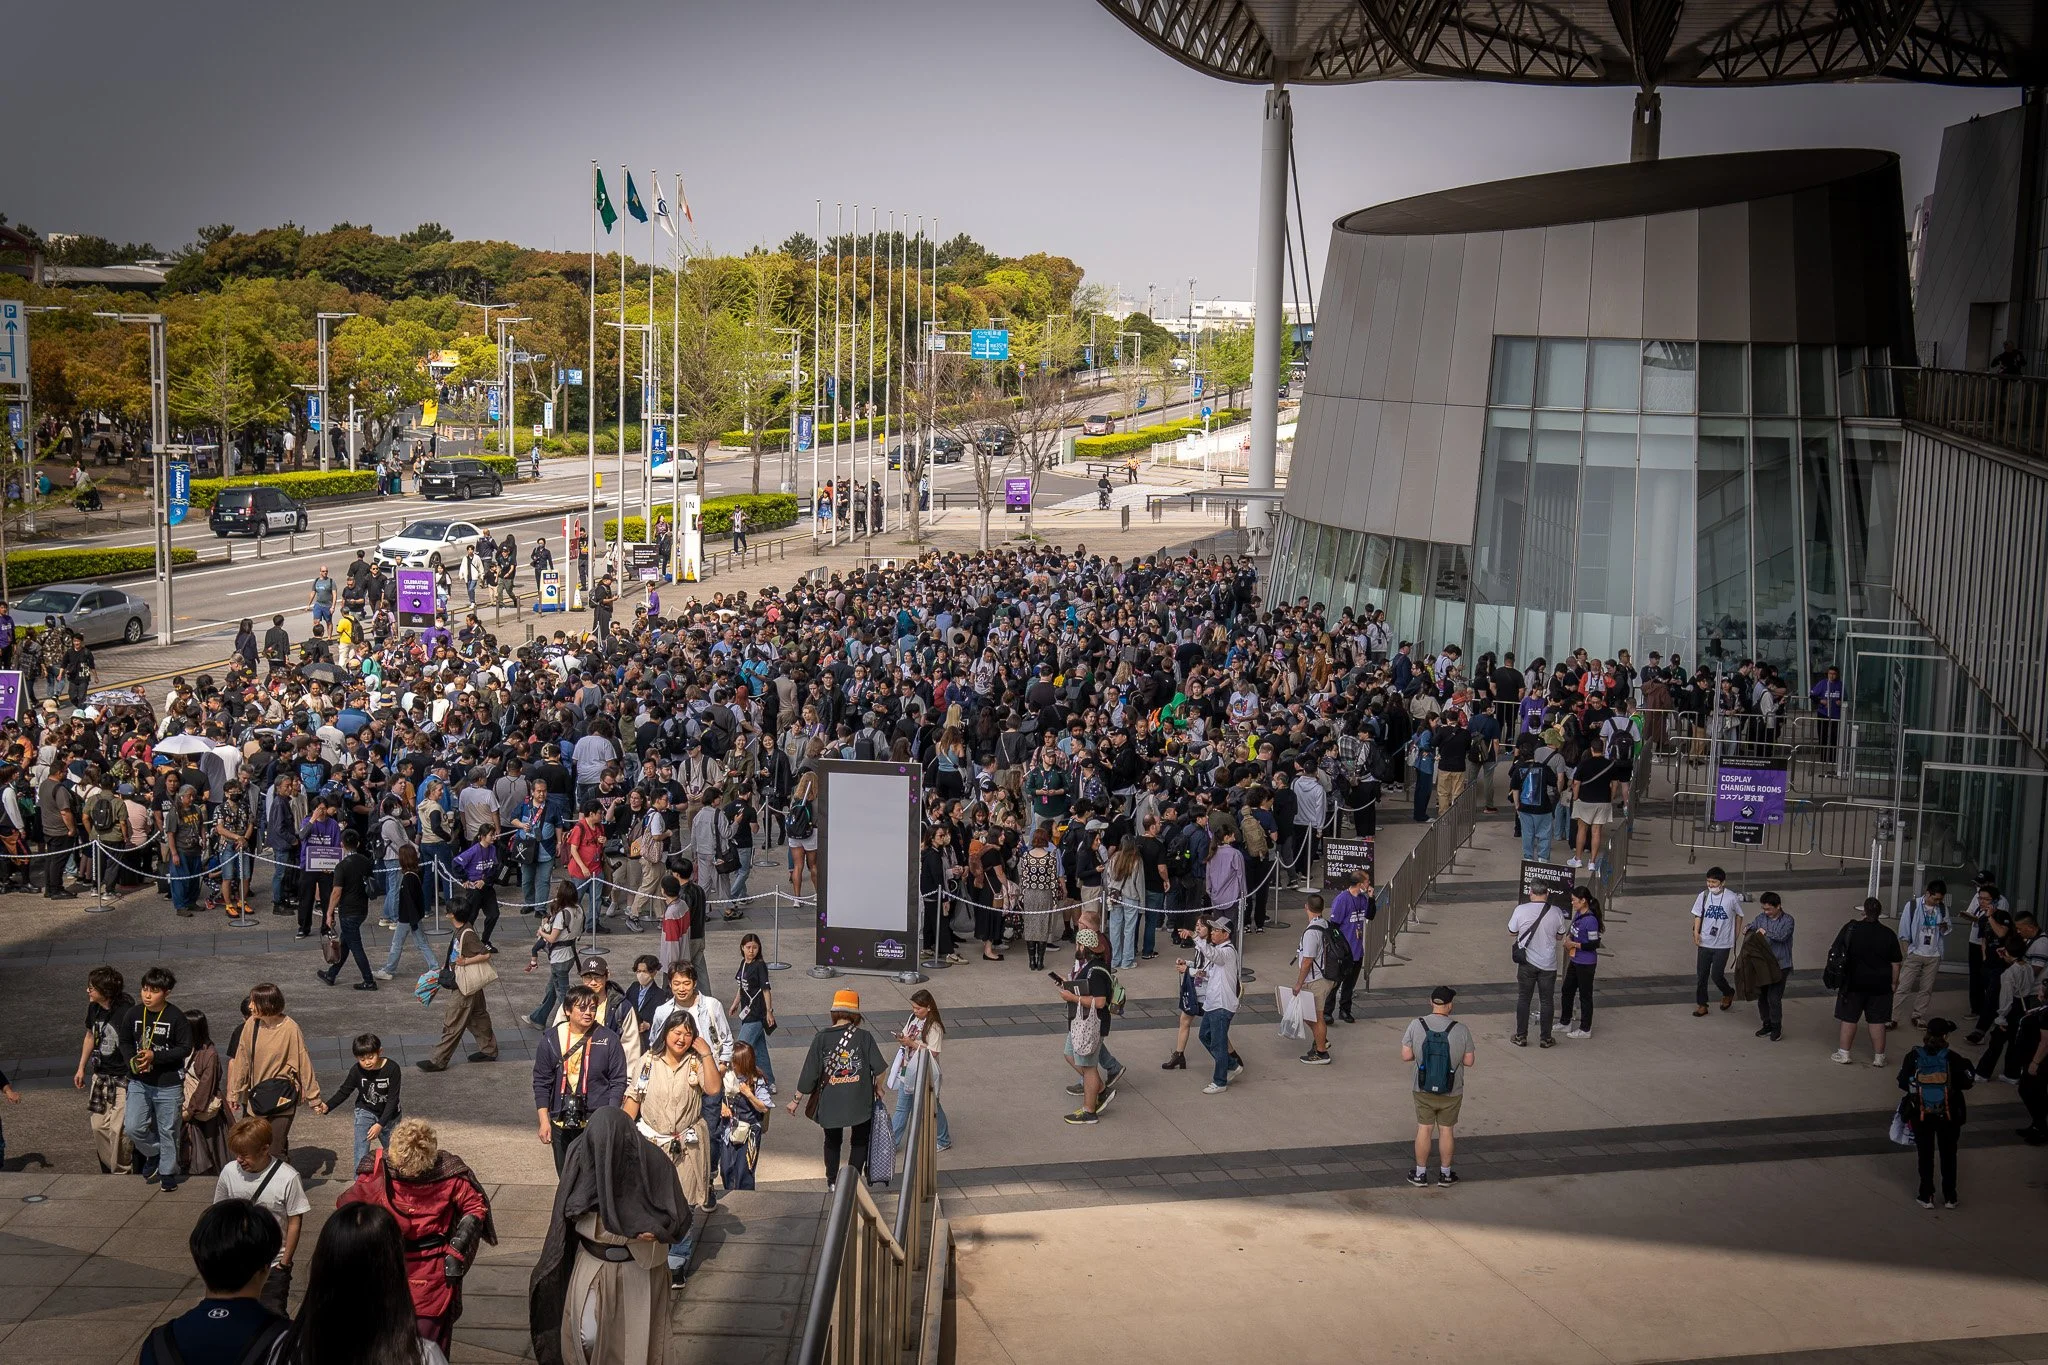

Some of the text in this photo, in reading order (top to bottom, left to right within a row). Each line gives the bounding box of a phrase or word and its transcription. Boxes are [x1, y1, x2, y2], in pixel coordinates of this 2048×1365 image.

[6, 306, 15, 317] P
[685, 501, 695, 509] IN
[1720, 784, 1756, 792] CHANGING
[1720, 794, 1764, 802] コスプレ更衣室
[1524, 866, 1557, 875] LIGHTSPEED
[1524, 872, 1560, 882] RESERVATION
[1704, 910, 1728, 920] WARS
